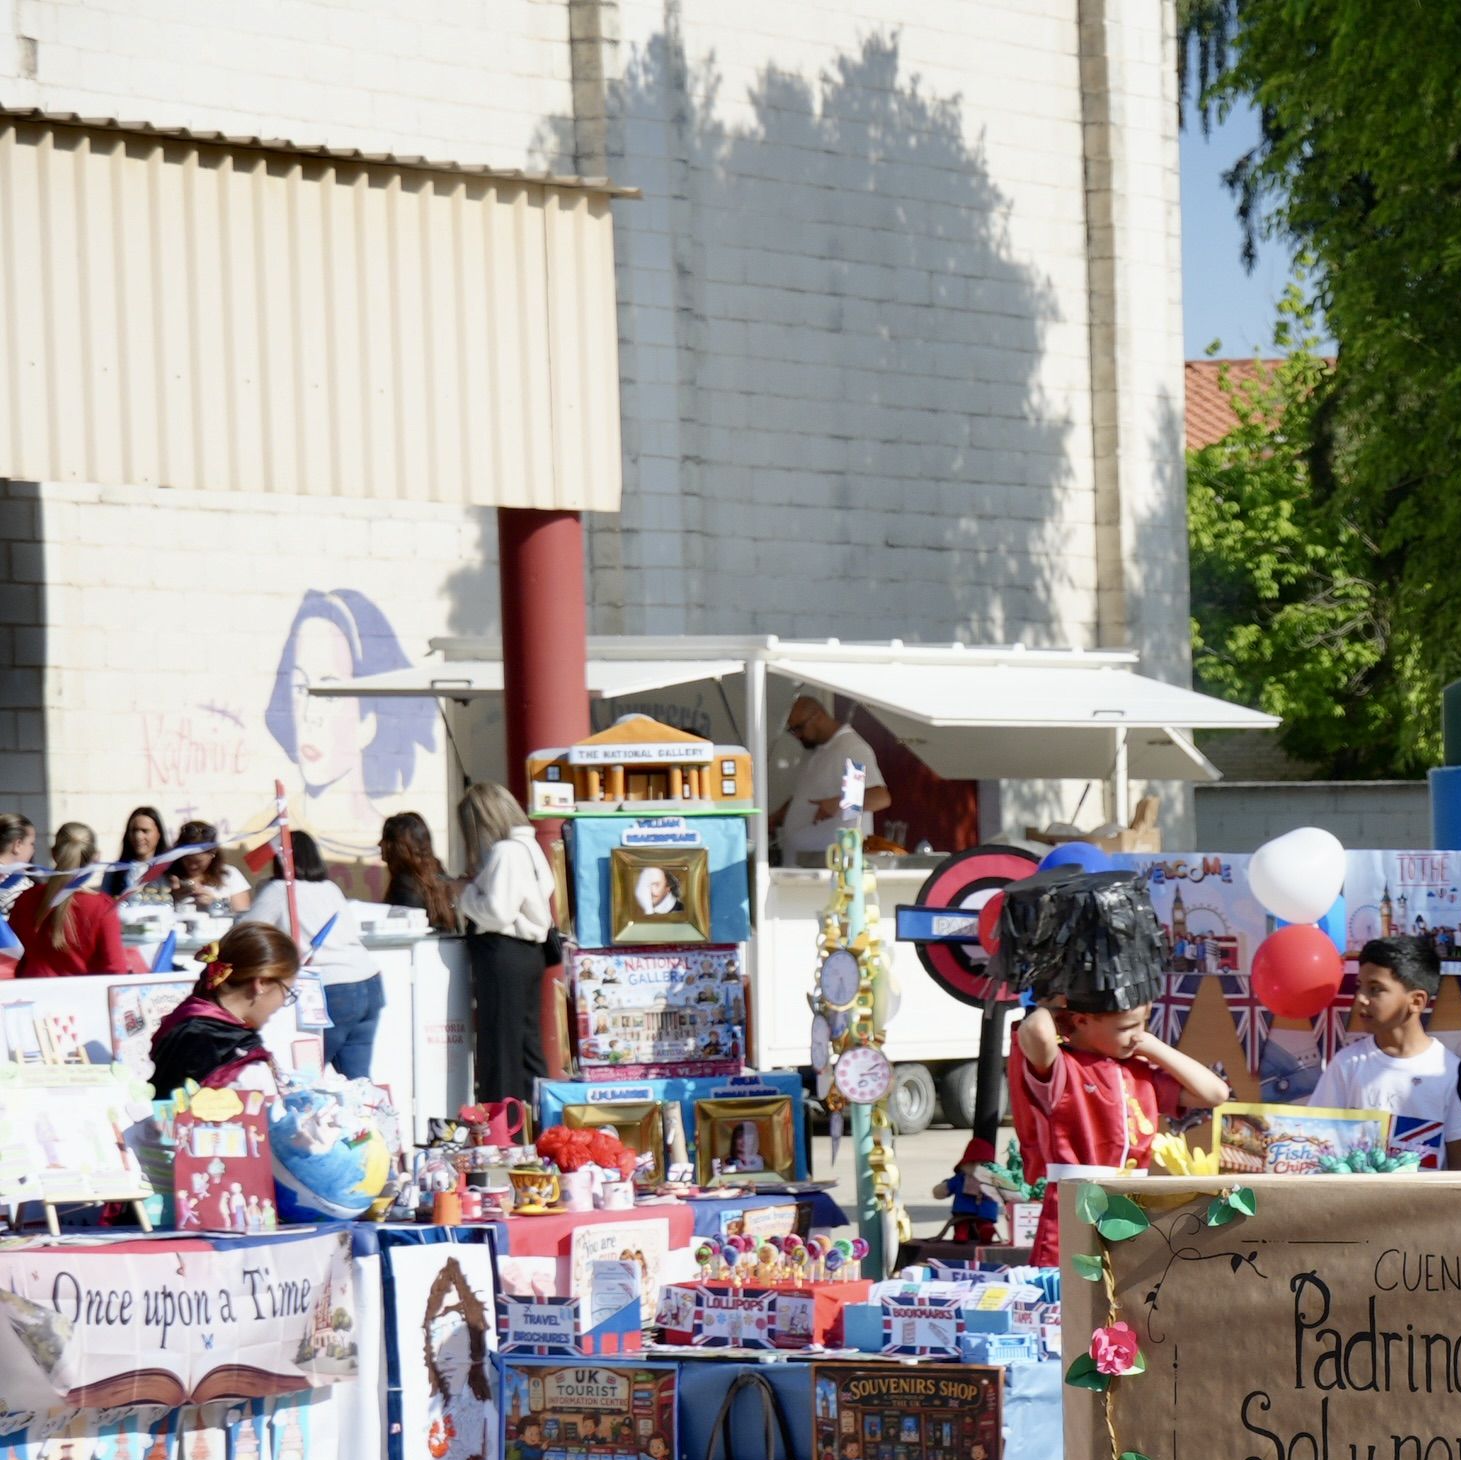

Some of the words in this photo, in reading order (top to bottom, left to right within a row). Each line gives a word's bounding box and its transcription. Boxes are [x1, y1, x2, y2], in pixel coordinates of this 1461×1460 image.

[578, 750, 599, 759] THE
[603, 749, 652, 759] NATIONAL
[657, 748, 705, 759] GALLERY
[624, 957, 693, 973] NATIONAL
[1268, 1142, 1314, 1166] Fish
[53, 1271, 133, 1326] Once
[143, 1284, 215, 1349] upon
[220, 1288, 237, 1324] a
[243, 1266, 312, 1321] Time
[706, 1298, 764, 1311] LOLLIPOPS
[523, 1313, 560, 1326] TRAVEL
[892, 1306, 953, 1321] BOOKMARKS
[513, 1331, 571, 1344] BROCHURES
[575, 1370, 600, 1384] UK
[556, 1385, 619, 1397] TOURIST
[850, 1378, 936, 1401] SOUVENIRS
[939, 1379, 979, 1401] SHOP
